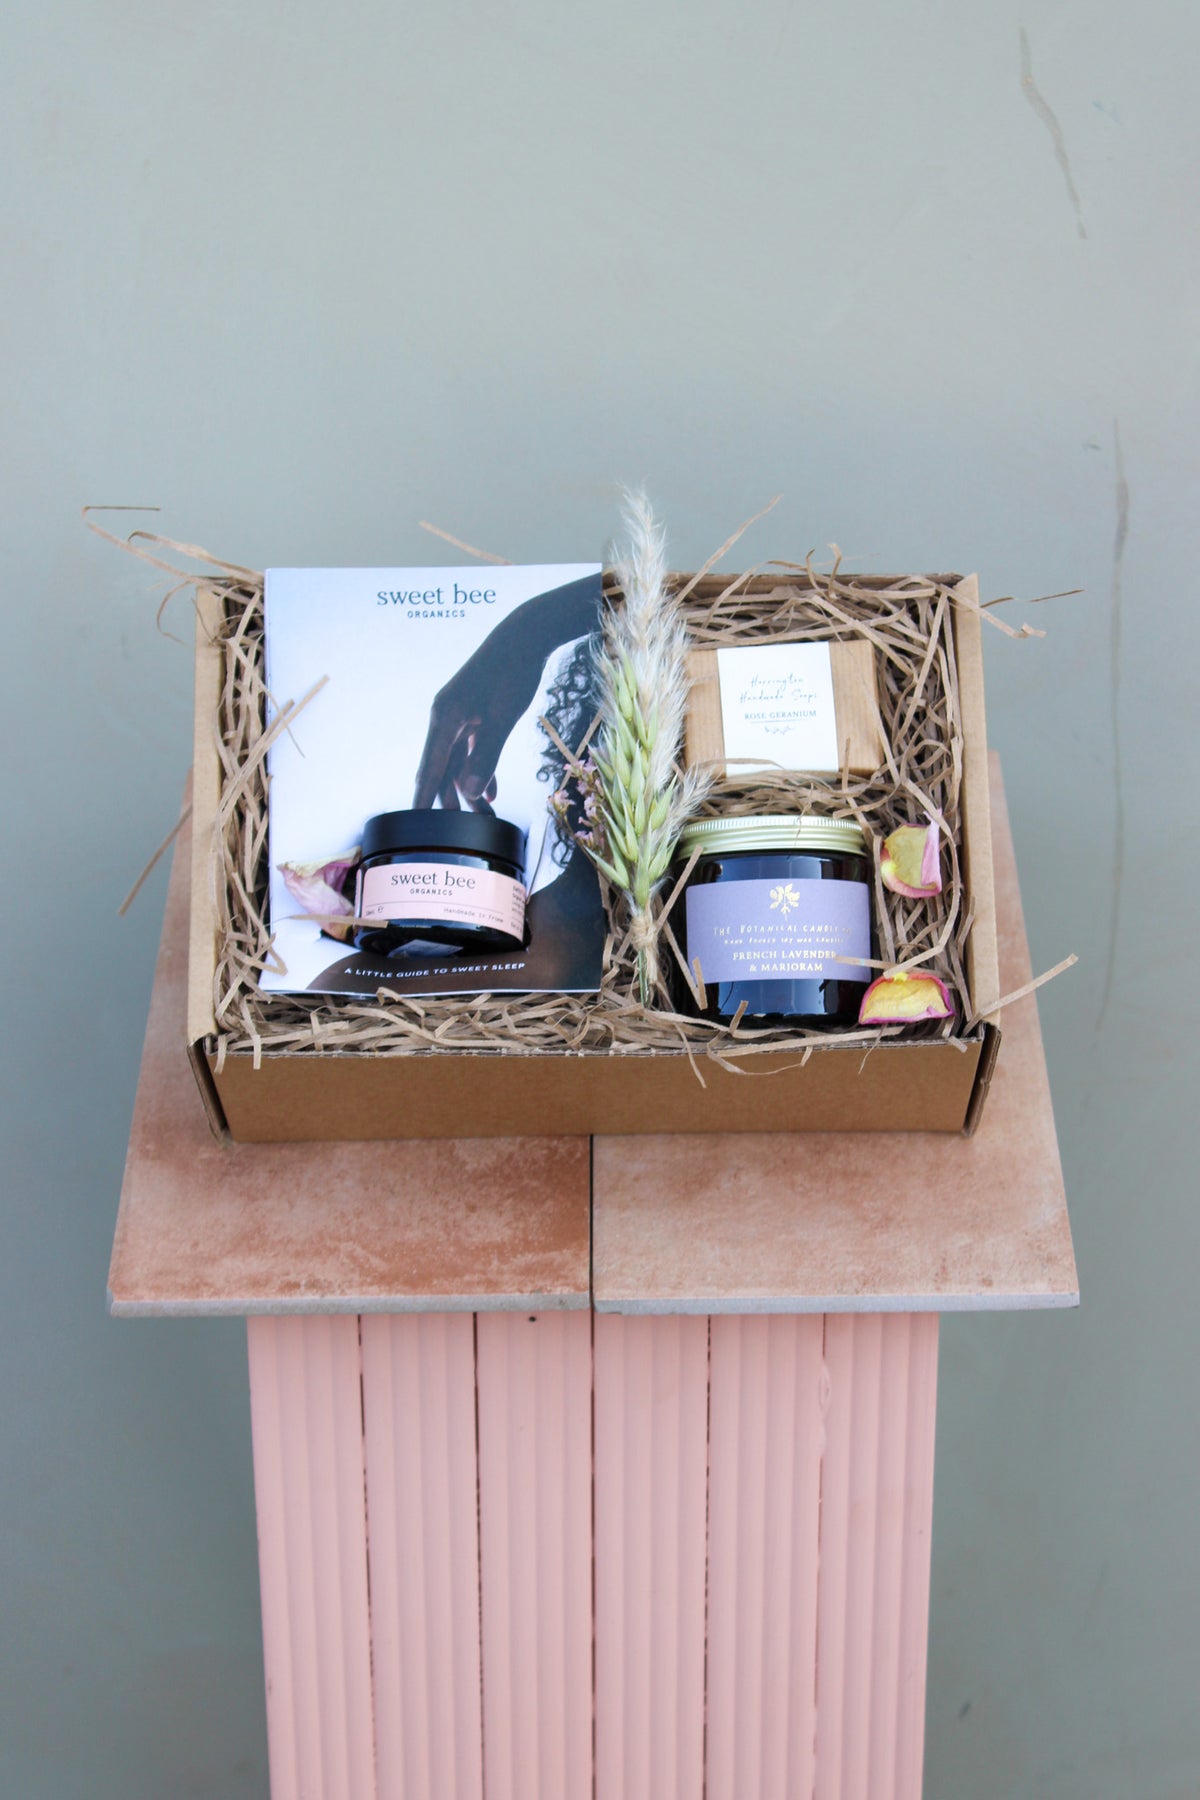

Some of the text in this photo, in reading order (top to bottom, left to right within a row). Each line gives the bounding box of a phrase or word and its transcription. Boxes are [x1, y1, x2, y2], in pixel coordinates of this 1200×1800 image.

[376, 583, 496, 605] sweet bee
[407, 610, 466, 618] ORGANICS
[744, 710, 816, 720] ROSE GERANIUM
[390, 870, 476, 889] sweet bee
[410, 888, 453, 896] ORGANICS
[713, 926, 731, 936] THE
[732, 950, 776, 960] FRENCH
[356, 968, 392, 978] LITTLE
[396, 970, 430, 978] GUIDE
[451, 965, 488, 973] SWEET
[491, 962, 526, 971] SLEEP
[749, 962, 822, 972] & MARJORAM
